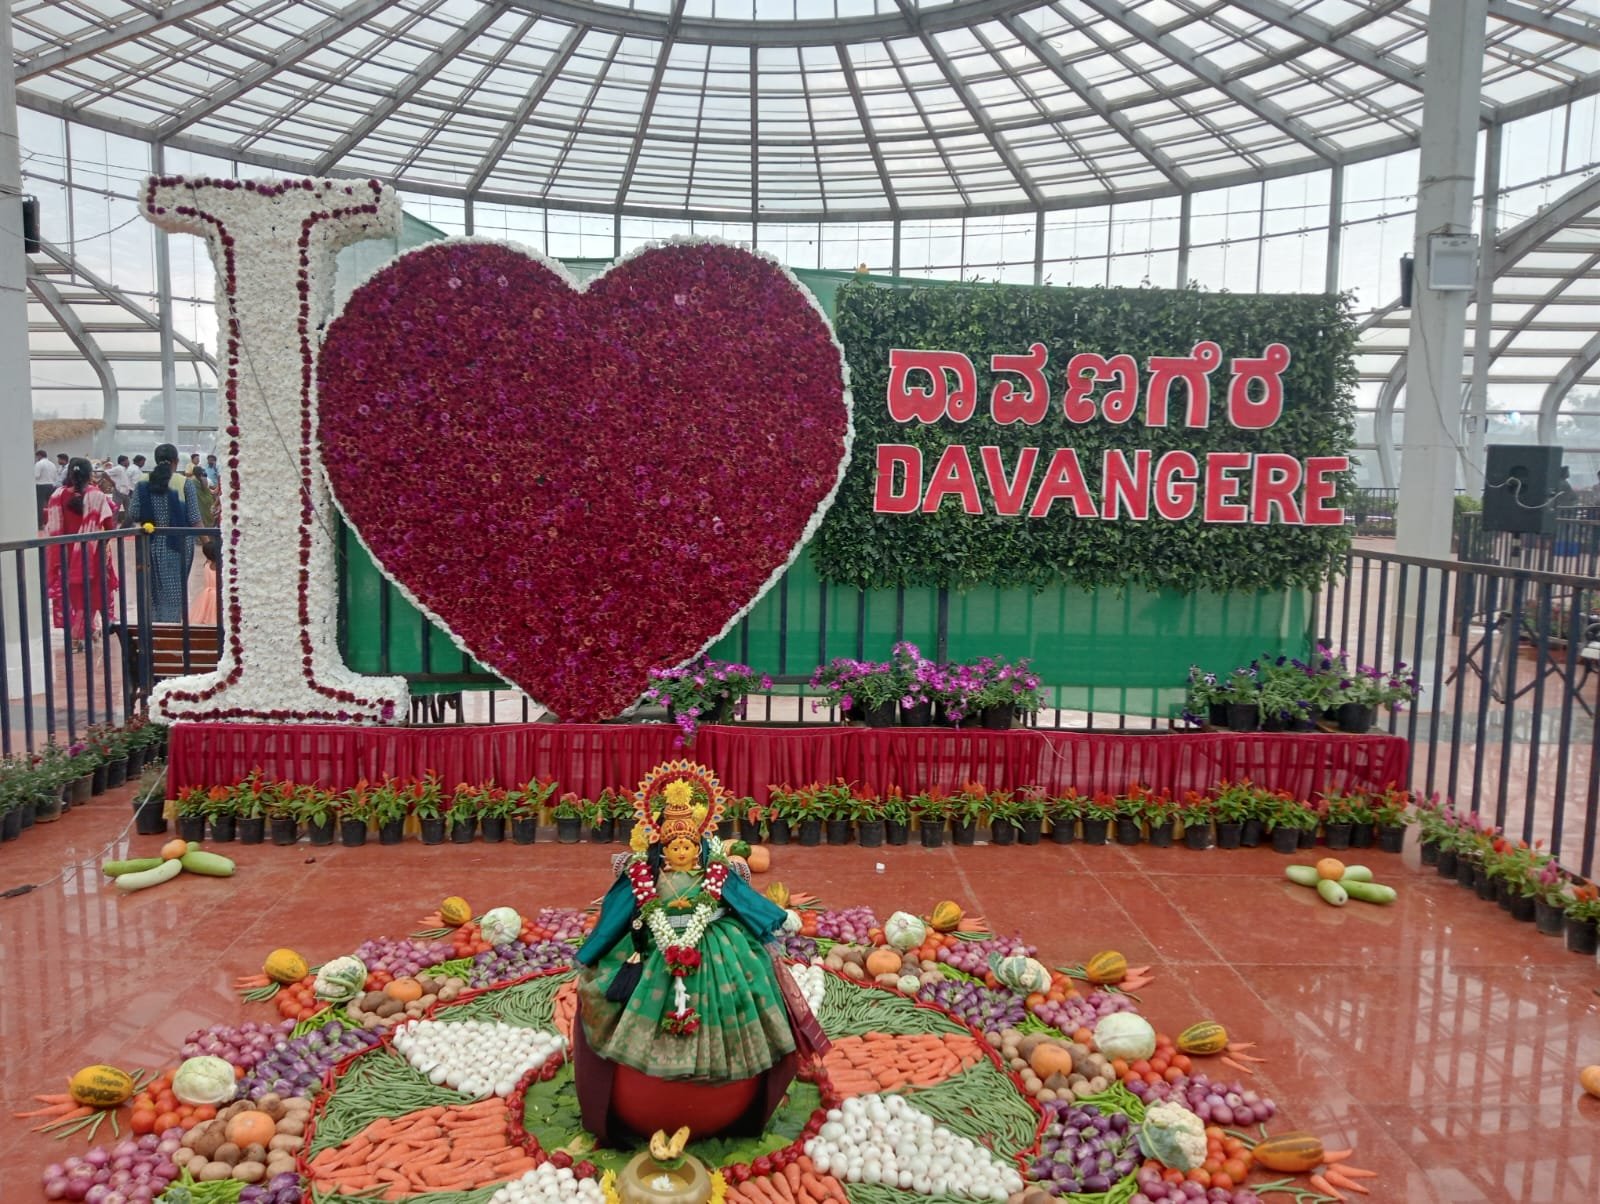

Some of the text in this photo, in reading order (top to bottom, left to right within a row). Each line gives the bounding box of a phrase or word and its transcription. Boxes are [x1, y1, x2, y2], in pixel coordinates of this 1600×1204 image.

[887, 341, 1291, 429] ದಾವಣಗೆರೆ
[139, 174, 407, 726] I
[873, 443, 1349, 525] DAVANGERE
